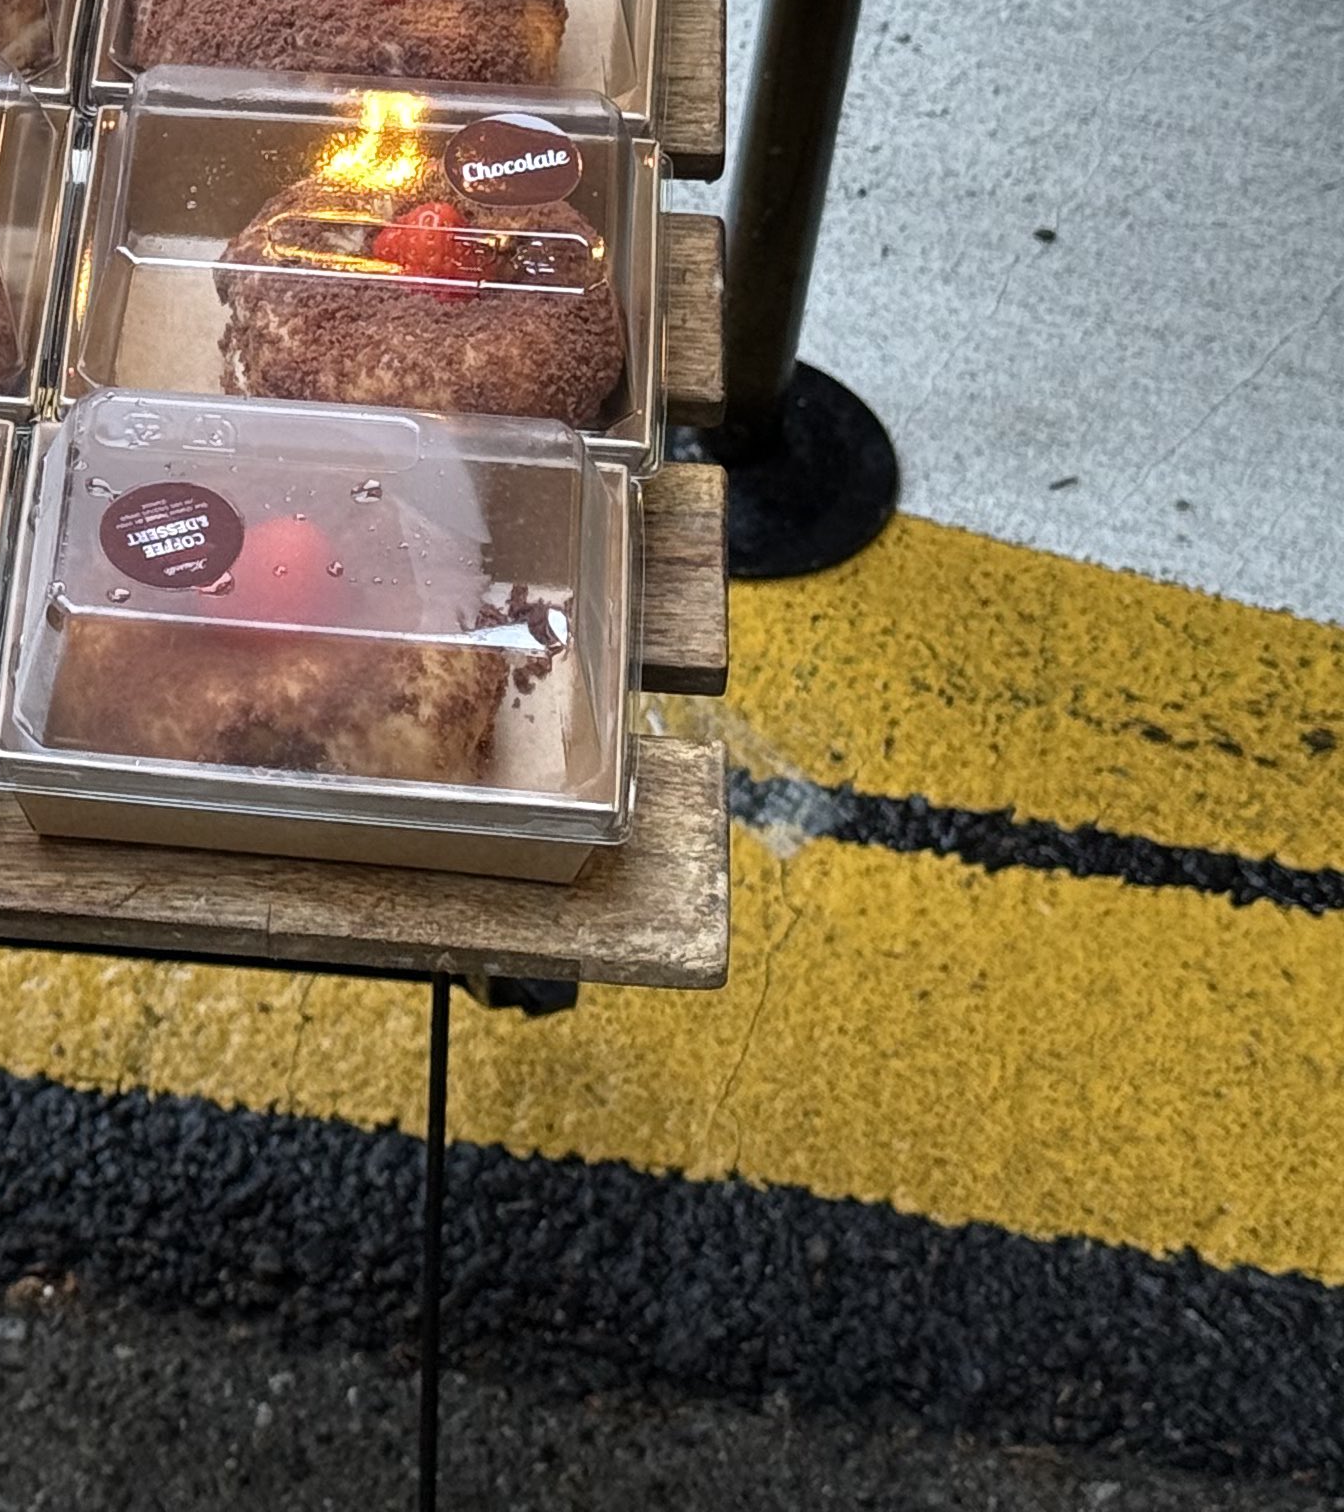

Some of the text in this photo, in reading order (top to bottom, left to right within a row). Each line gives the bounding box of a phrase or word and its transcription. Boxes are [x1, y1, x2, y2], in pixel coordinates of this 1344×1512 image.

[463, 149, 570, 182] Chocolate
[127, 515, 209, 546] &DESSERT
[143, 533, 205, 558] COFFEE
